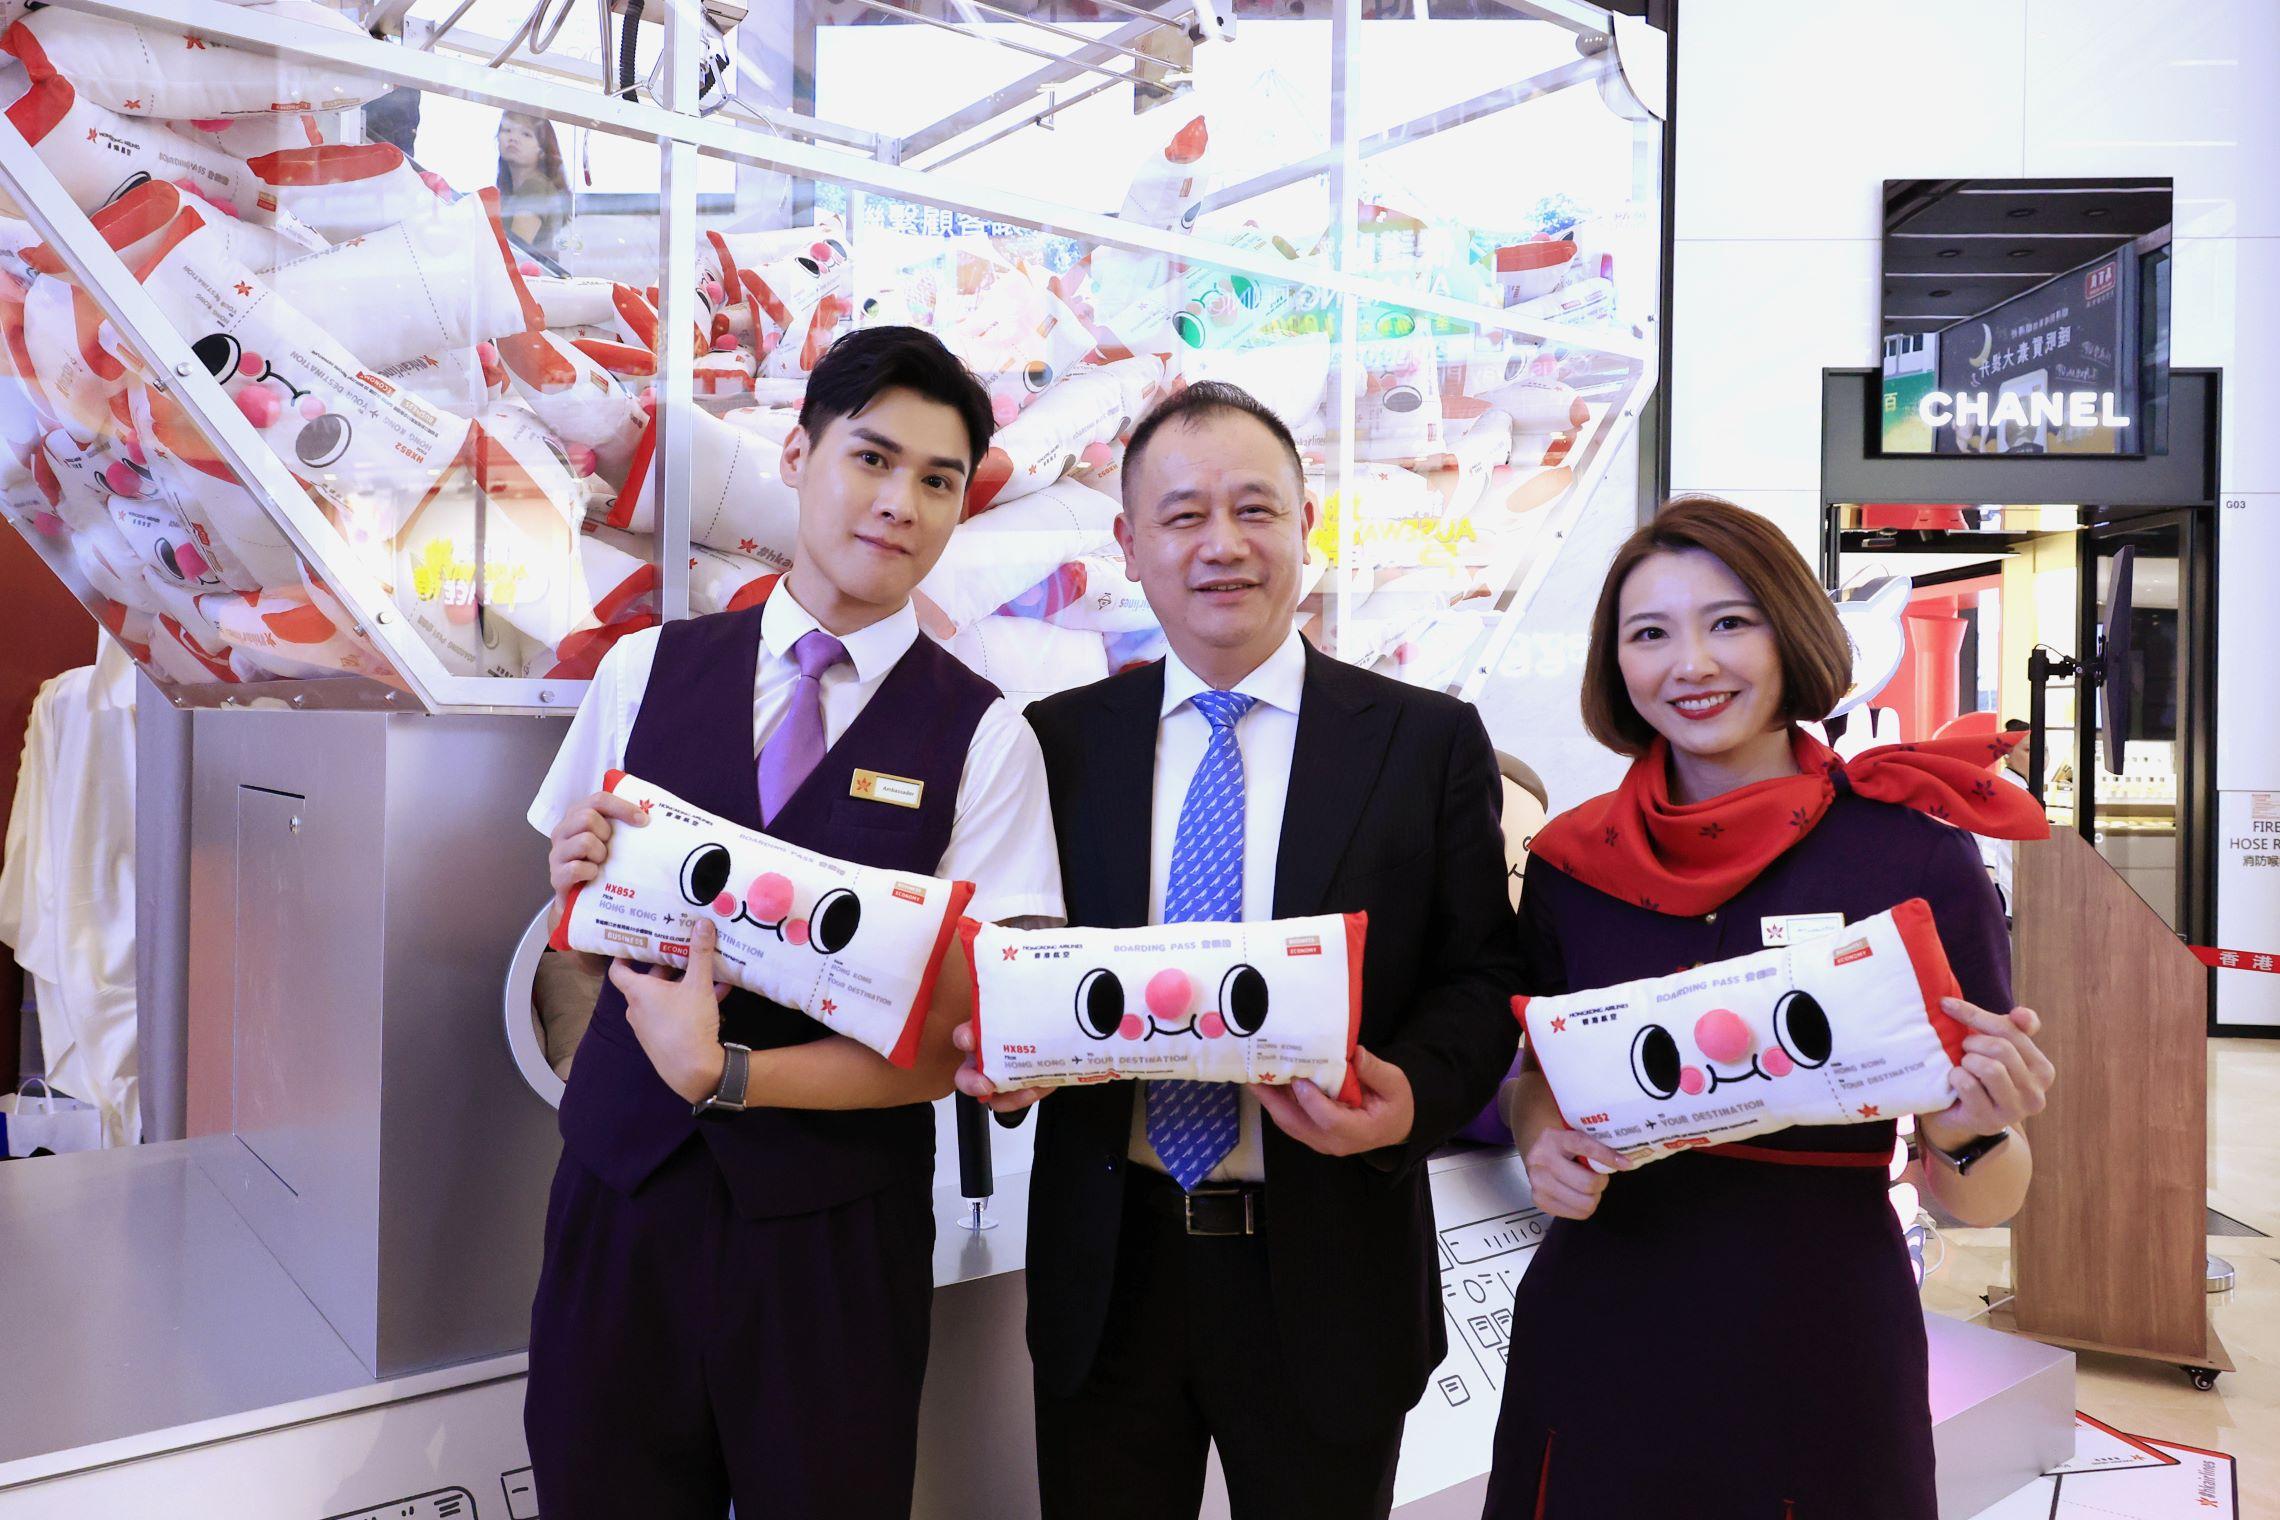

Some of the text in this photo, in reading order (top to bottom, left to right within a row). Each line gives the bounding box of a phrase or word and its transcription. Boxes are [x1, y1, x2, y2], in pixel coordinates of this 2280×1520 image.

[290, 350, 345, 393] DESTINATION
[1918, 391, 2131, 428] CHANEL
[394, 441, 425, 464] HX852
[2226, 500, 2246, 509] G03
[2253, 820, 2280, 833] FIRE
[2230, 837, 2268, 850] HOSE
[604, 882, 636, 899] HX852
[598, 900, 765, 960] HONG KONG YO STINATION
[662, 943, 689, 956] ECONO
[1113, 943, 1166, 953] BOARDING
[1170, 941, 1196, 951] PASS
[1289, 946, 1318, 955] ECONOMY
[1837, 950, 1869, 965] ECONOMY
[1656, 981, 1708, 1003] BOARDING
[1711, 975, 1741, 988] PASS
[1003, 1044, 1037, 1054] HX852
[1004, 1055, 1188, 1070] HONG KONG YOUR DESTINATION
[1579, 1112, 1610, 1127] HX852
[1614, 1125, 1642, 1138] KONG
[1661, 1116, 1689, 1128] YOUR
[1692, 1099, 1765, 1122] DESTINATION
